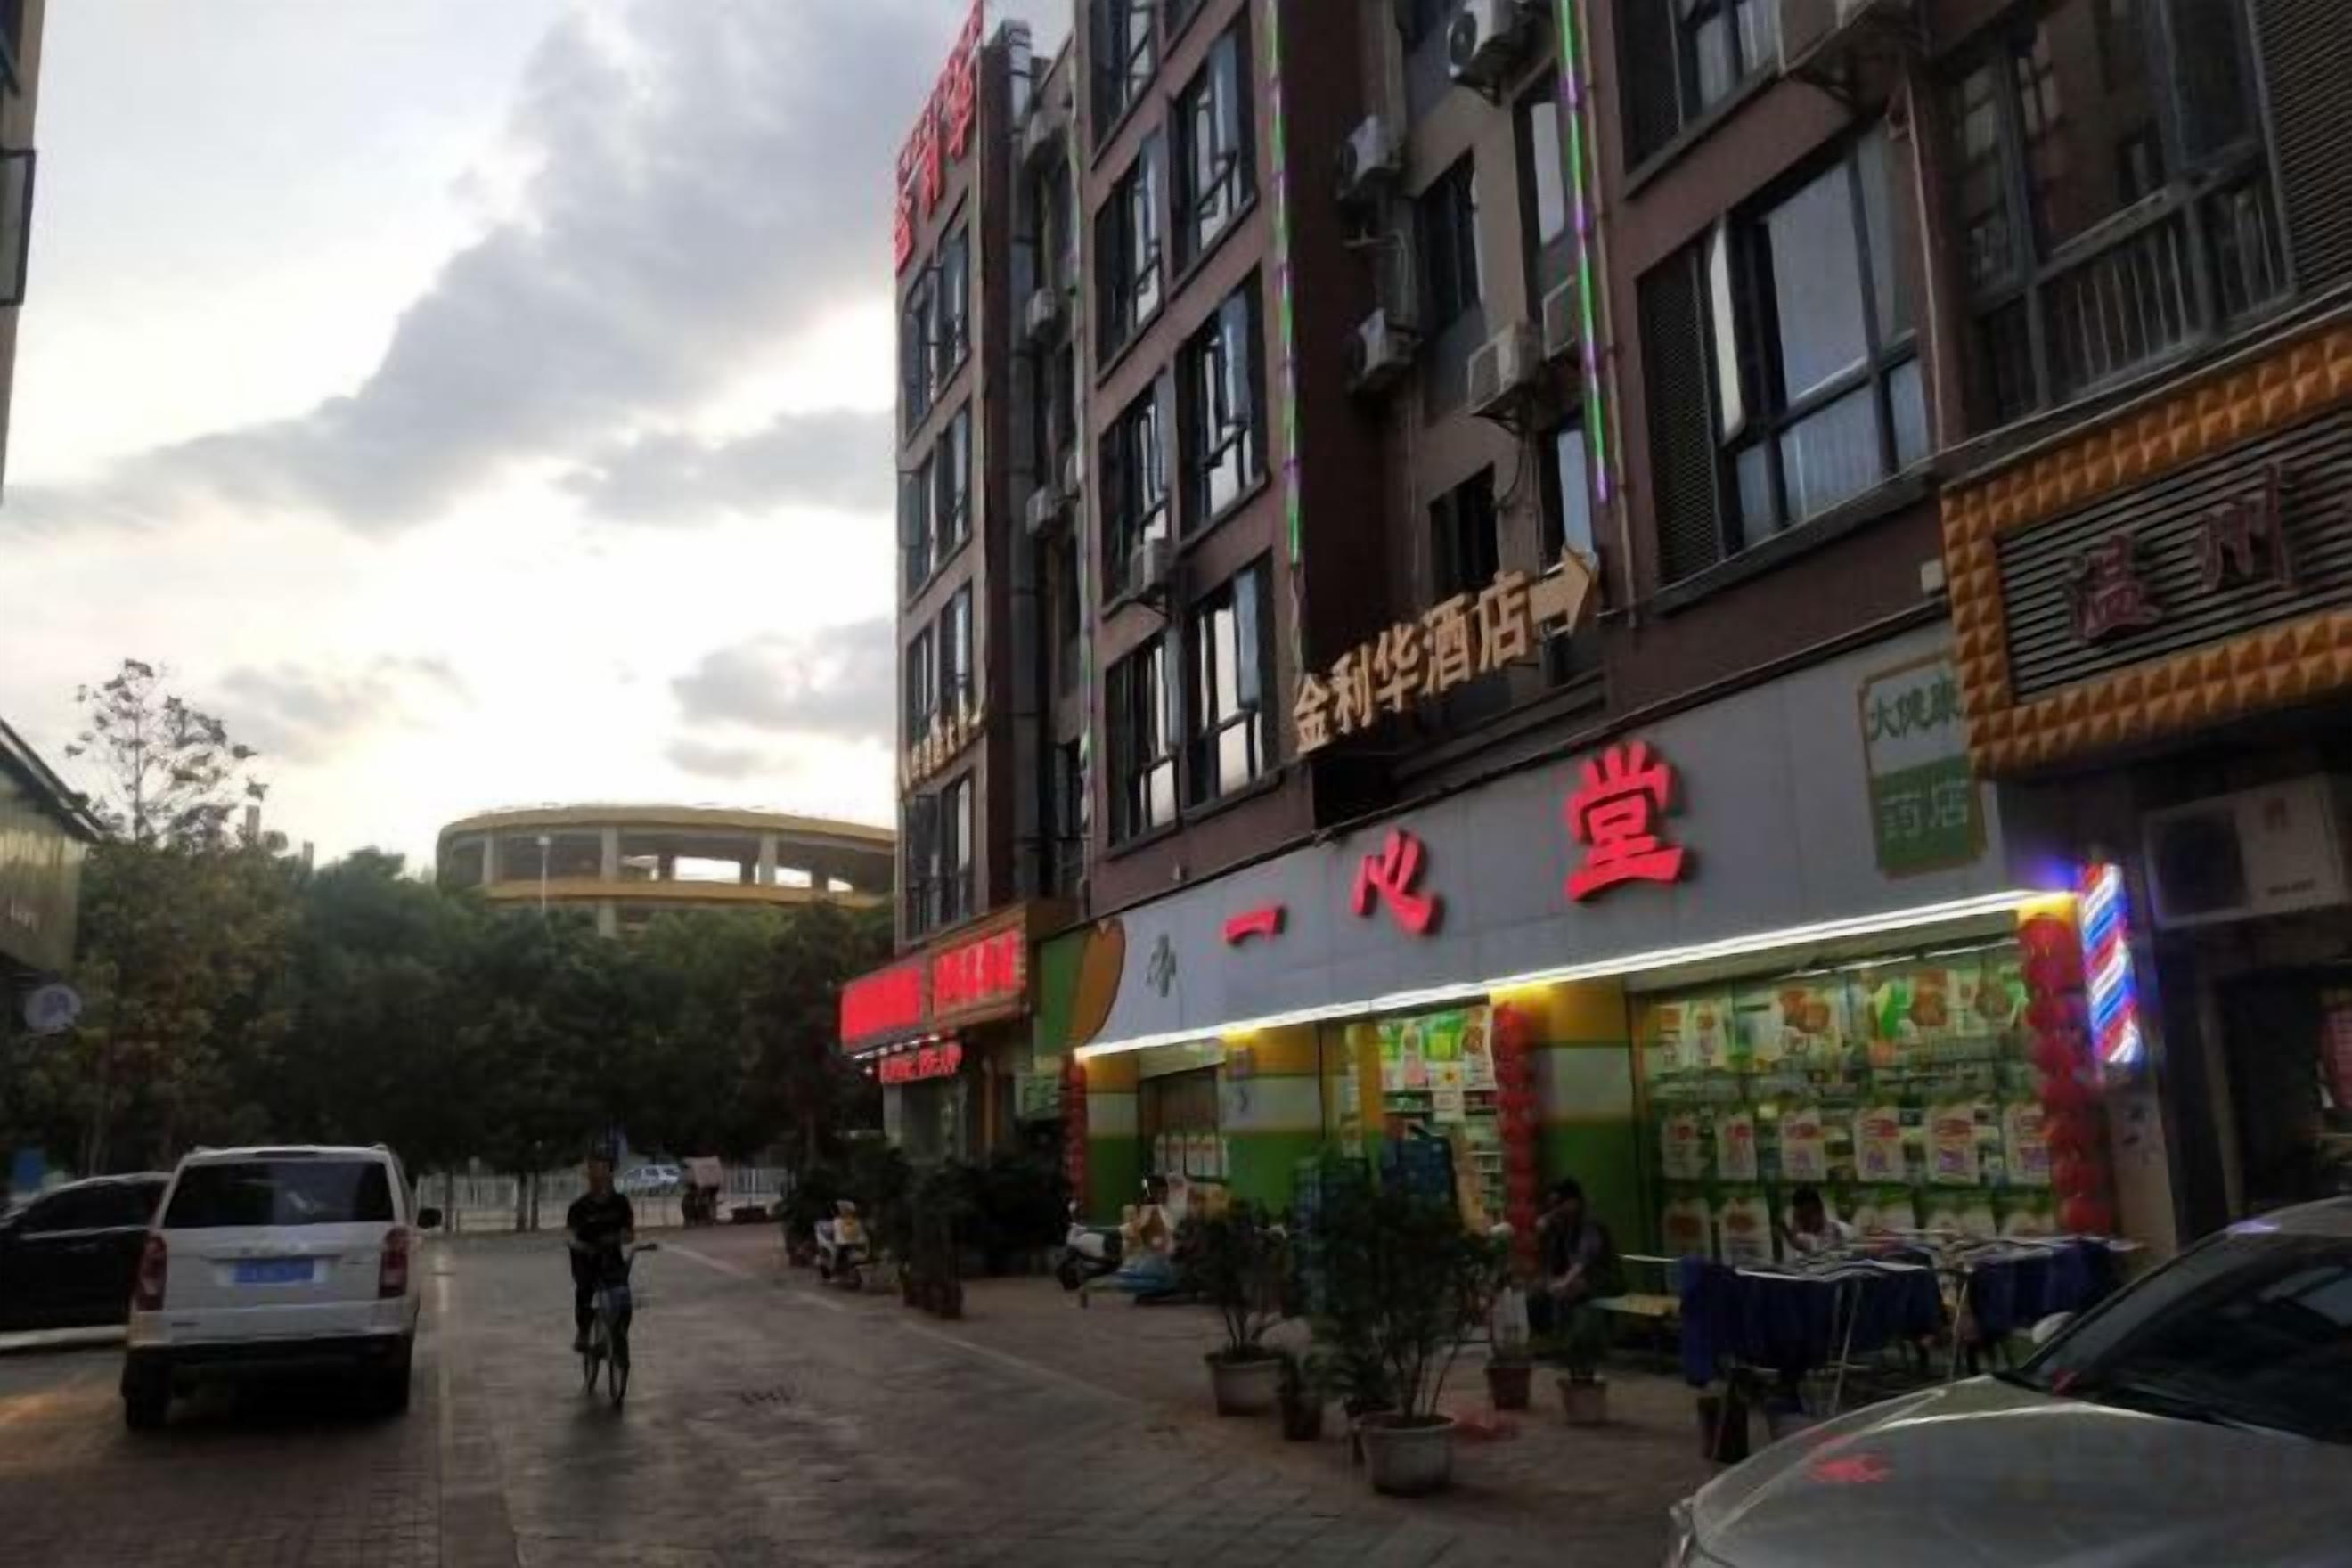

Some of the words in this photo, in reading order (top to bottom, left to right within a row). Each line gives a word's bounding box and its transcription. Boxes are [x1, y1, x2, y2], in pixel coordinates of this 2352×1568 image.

[1294, 569, 1530, 755] 金利华酒店
[1223, 739, 1685, 946] 一心堂
